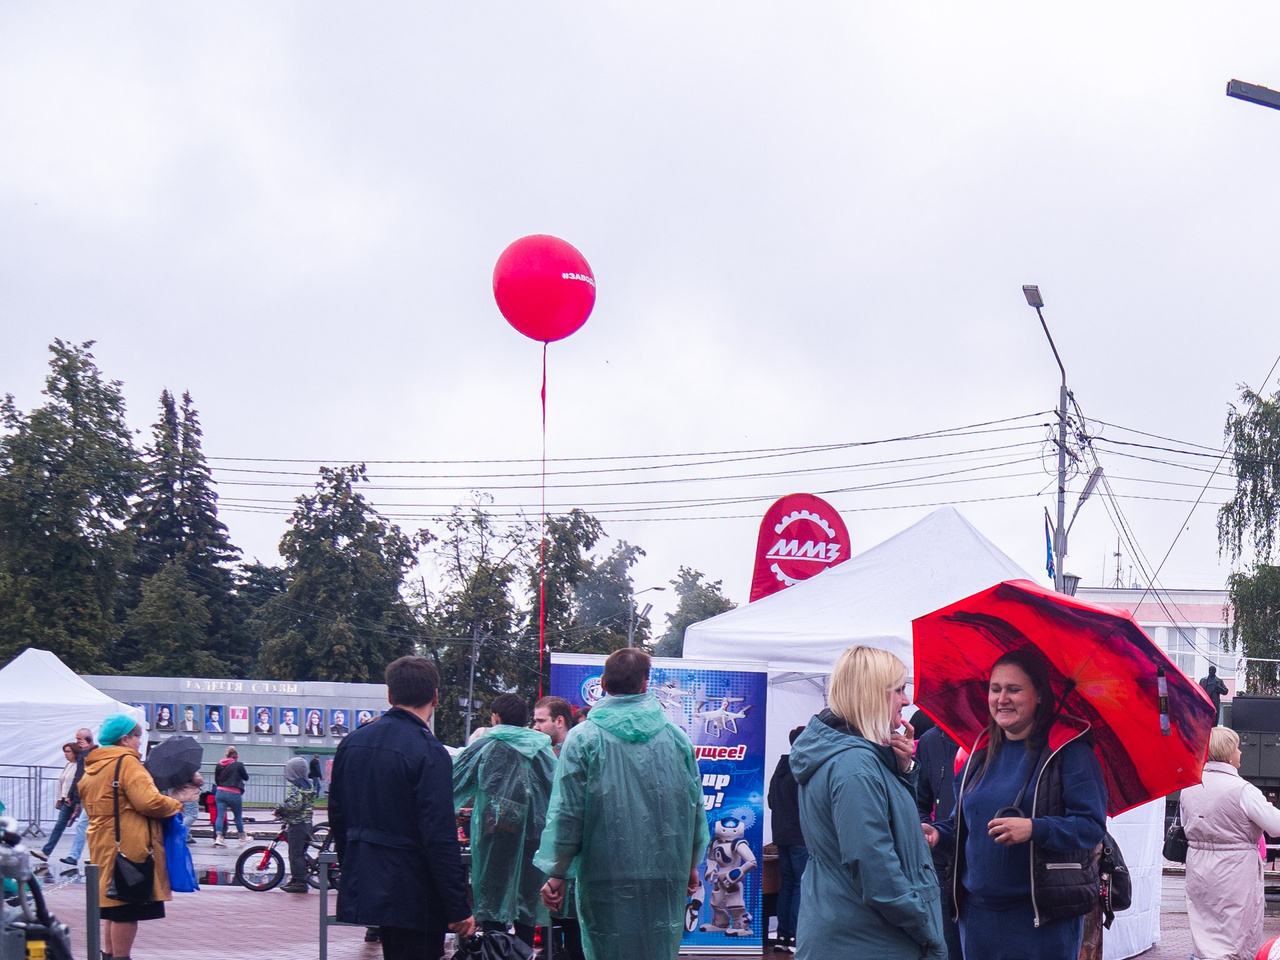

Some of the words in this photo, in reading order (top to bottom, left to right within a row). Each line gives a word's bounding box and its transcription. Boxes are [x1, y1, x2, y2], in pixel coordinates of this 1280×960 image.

[766, 538, 842, 562] ММЗ
[251, 682, 298, 693] СЛАВЫ
[694, 745, 747, 761] ущее!
[702, 773, 730, 790] ир
[703, 792, 724, 811] у!
